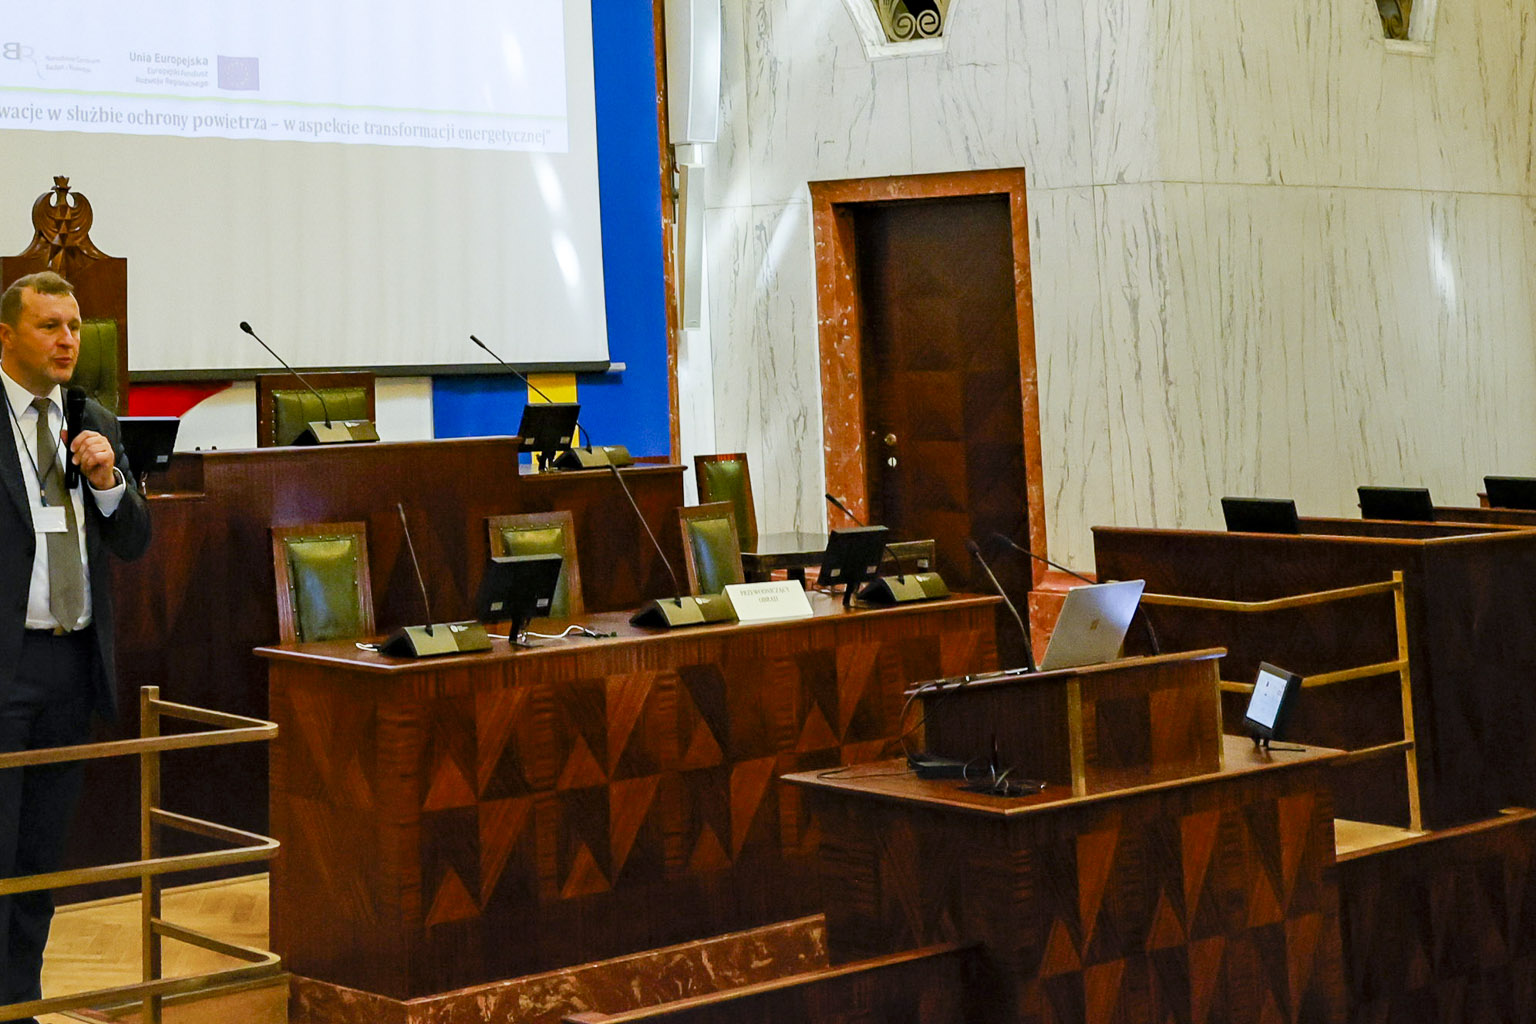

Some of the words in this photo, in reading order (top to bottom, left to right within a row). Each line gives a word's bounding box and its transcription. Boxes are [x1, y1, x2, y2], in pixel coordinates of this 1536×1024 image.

[129, 51, 152, 65] Unia
[154, 52, 208, 68] Europejska
[47, 106, 62, 121] w
[66, 104, 123, 125] służbie
[127, 110, 189, 131] ochrony
[192, 113, 268, 134] powietrza
[283, 118, 296, 132] w
[297, 117, 360, 138] aspekcie
[364, 120, 455, 142] transformacji
